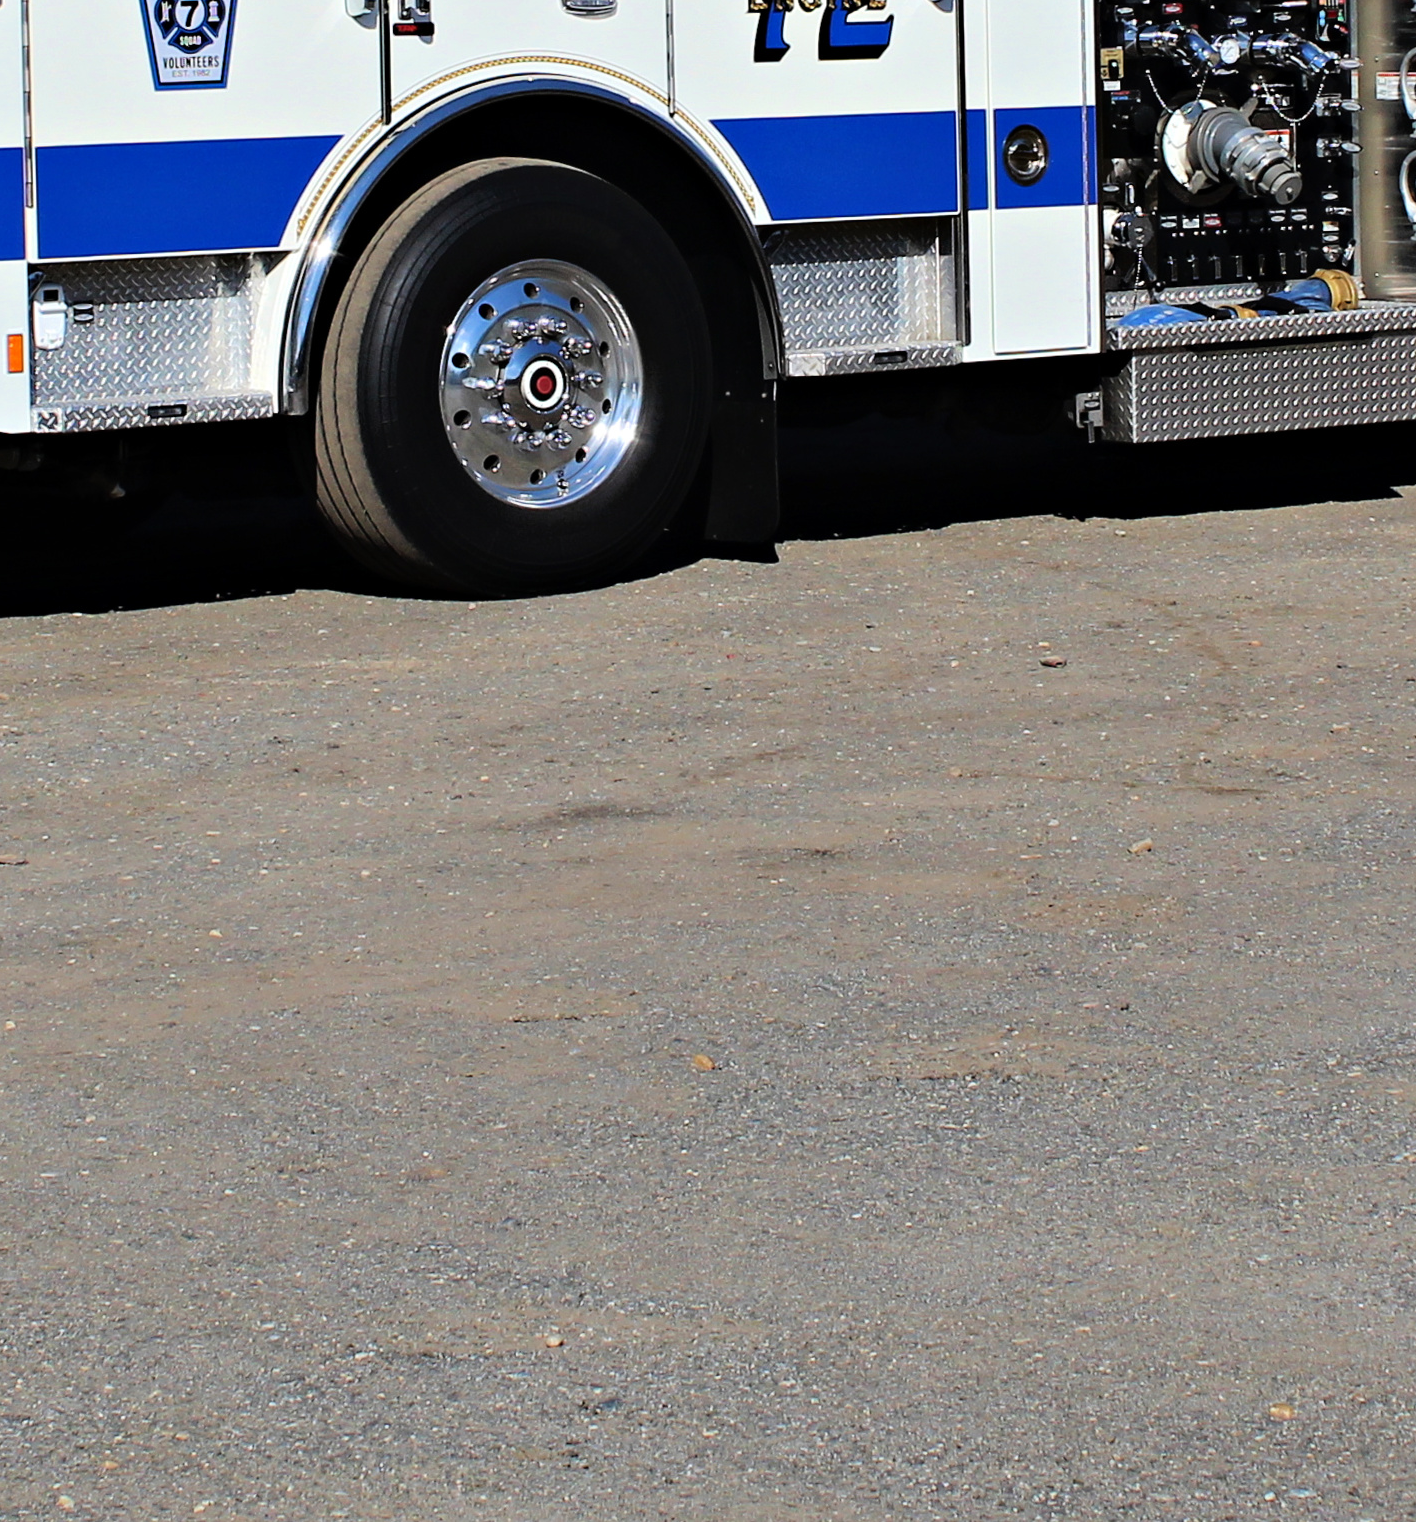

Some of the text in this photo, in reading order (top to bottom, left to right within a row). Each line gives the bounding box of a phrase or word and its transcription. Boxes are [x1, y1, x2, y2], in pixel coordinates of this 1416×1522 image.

[180, 0, 199, 28] 7
[179, 35, 202, 48] SQUAD
[163, 55, 220, 69] VOLUNTEERS
